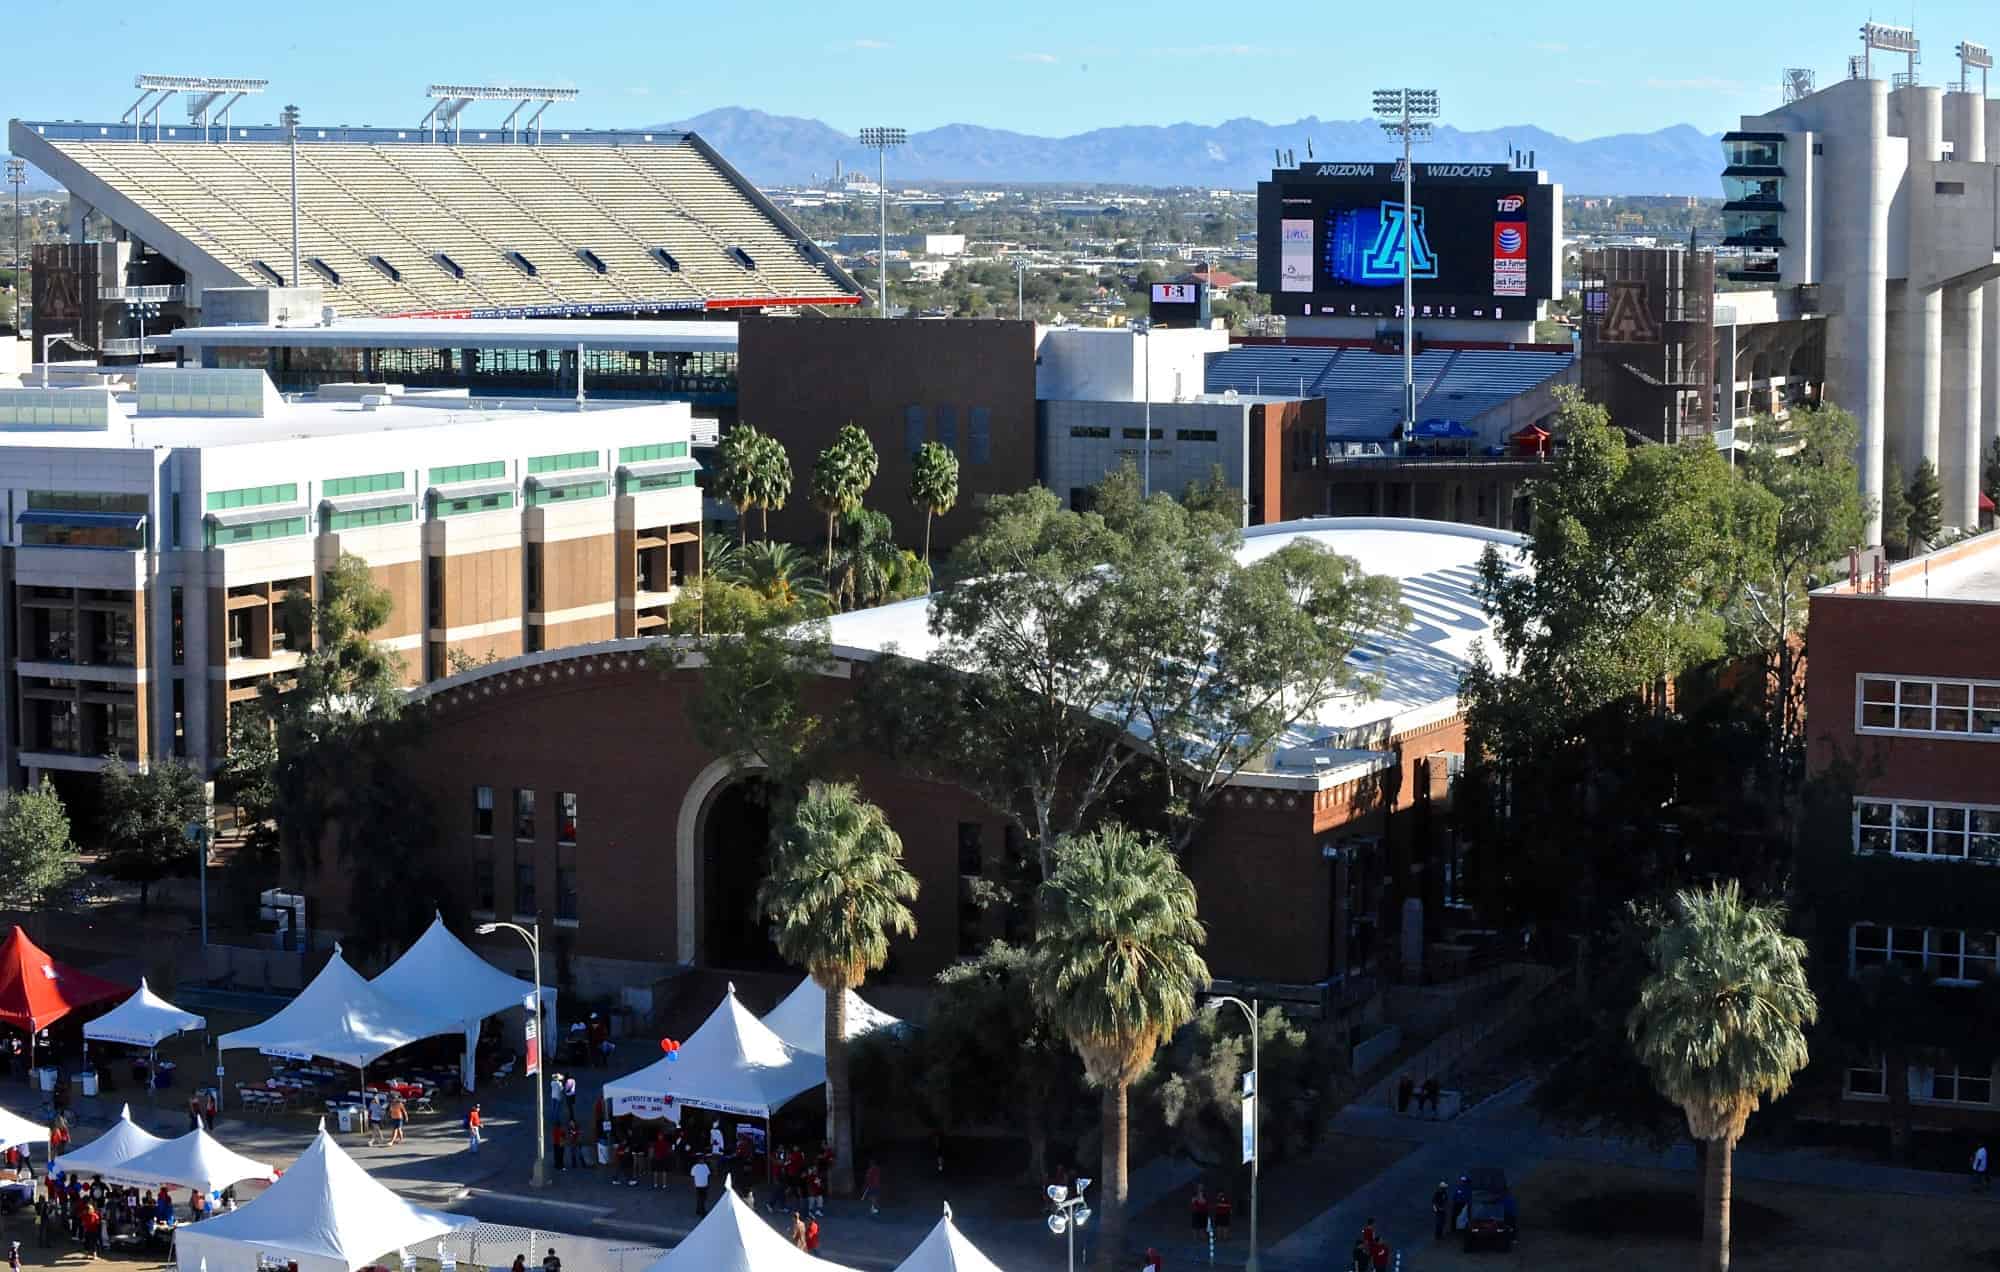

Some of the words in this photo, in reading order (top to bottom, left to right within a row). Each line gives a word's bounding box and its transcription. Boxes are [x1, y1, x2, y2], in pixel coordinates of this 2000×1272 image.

[1316, 164, 1374, 176] ARIZONA
[1427, 165, 1492, 177] WILDCATS
[1497, 199, 1522, 212] TEP
[1362, 200, 1438, 278] A
[1597, 280, 1663, 343] A
